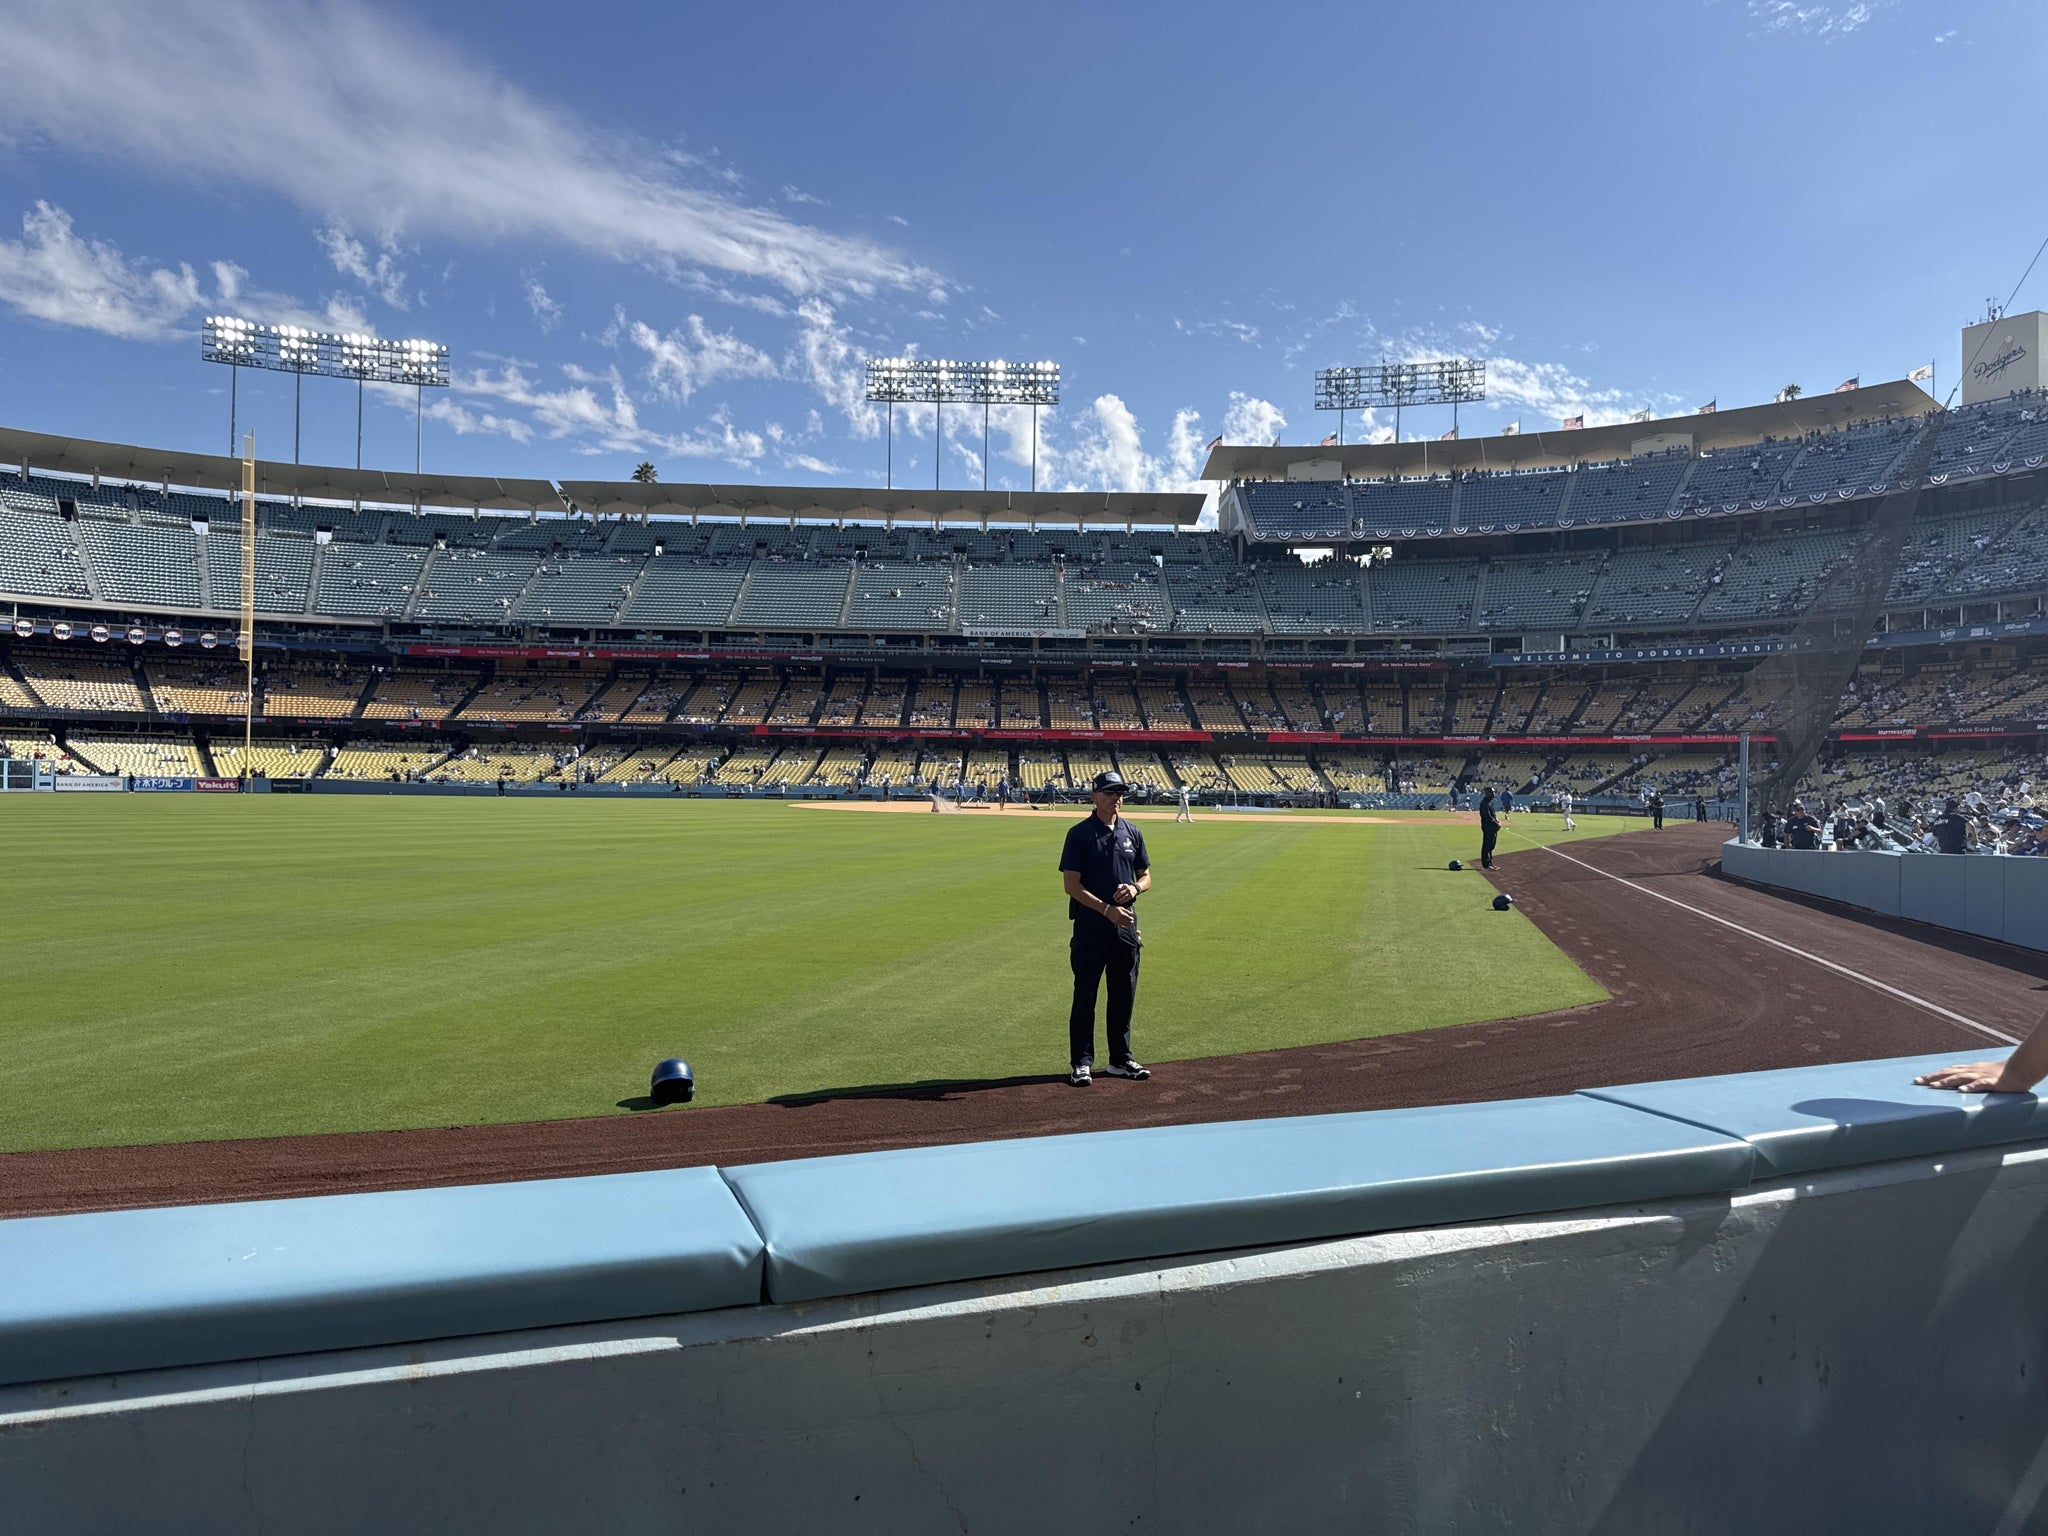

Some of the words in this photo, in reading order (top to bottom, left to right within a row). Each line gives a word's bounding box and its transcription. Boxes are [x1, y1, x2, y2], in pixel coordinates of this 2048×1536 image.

[1974, 346, 2026, 379] Dodgers
[1638, 648, 1704, 657] DODGER
[1720, 643, 1798, 654] STADIUM
[198, 781, 237, 789] Yakult
